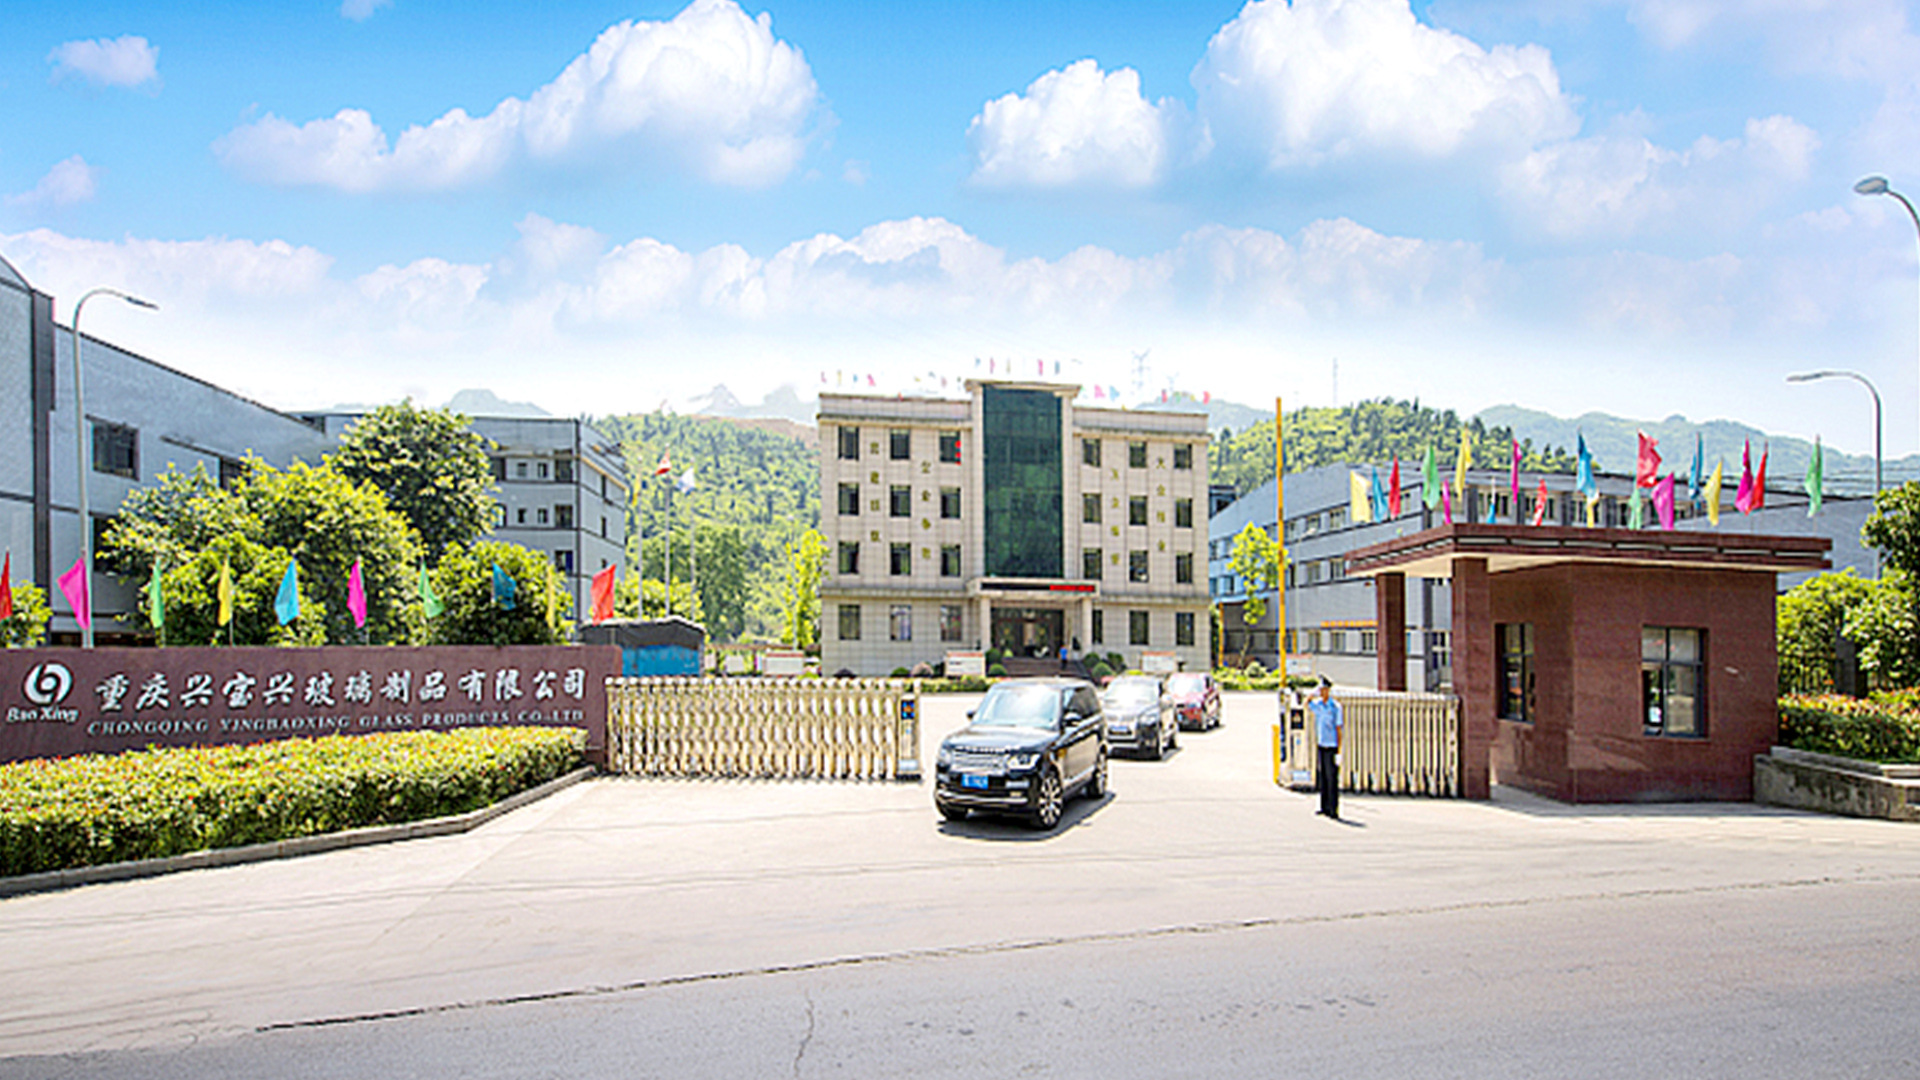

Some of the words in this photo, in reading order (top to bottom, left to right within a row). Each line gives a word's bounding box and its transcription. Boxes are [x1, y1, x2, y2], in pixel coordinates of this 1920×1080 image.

[94, 667, 586, 712] 重庆兴宝兴玻璃制品有限公司
[6, 707, 38, 722] Bao
[40, 706, 79, 722] Xing
[87, 718, 209, 735] CHONGQING
[220, 715, 350, 732] XINGBAOXING
[359, 713, 414, 728] GLASS
